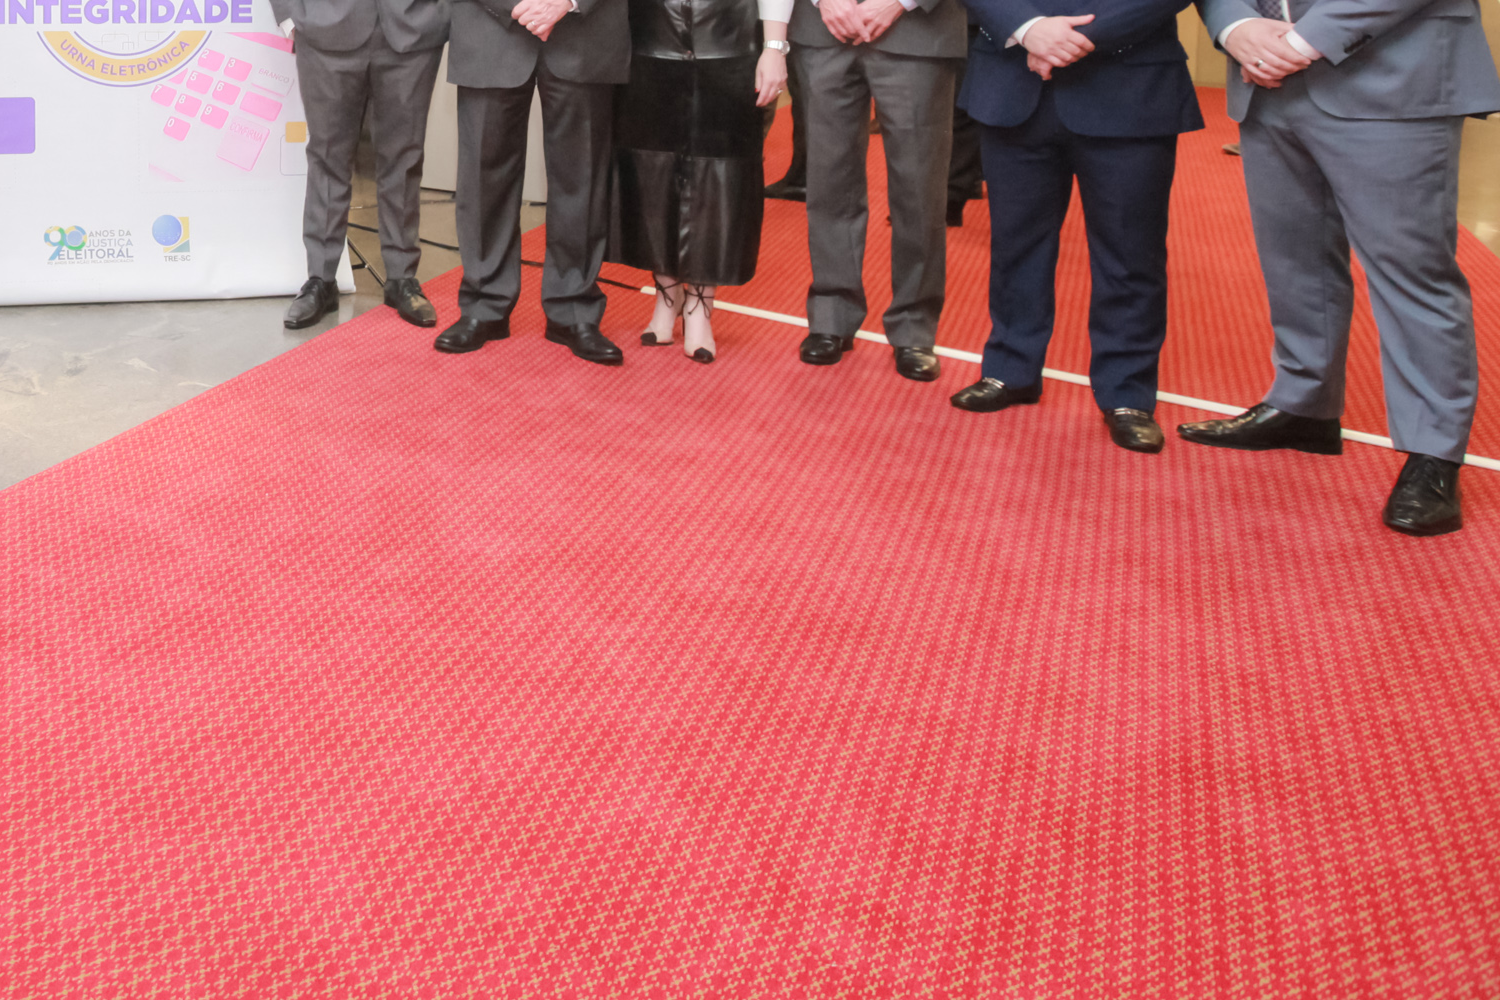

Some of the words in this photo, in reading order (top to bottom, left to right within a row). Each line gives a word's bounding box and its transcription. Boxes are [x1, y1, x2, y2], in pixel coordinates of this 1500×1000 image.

[60, 39, 96, 70] URNA
[100, 40, 190, 76] ELETRÔNICA
[201, 49, 210, 58] 2
[228, 58, 236, 68] 3
[190, 72, 198, 81] 5
[258, 68, 290, 83] BRANCO
[154, 85, 162, 93] 7
[216, 82, 225, 91] 6
[204, 106, 213, 115] 9
[118, 229, 132, 237] DA
[85, 238, 134, 248] JUSTIÇA
[58, 247, 134, 260] ELEITORAL
